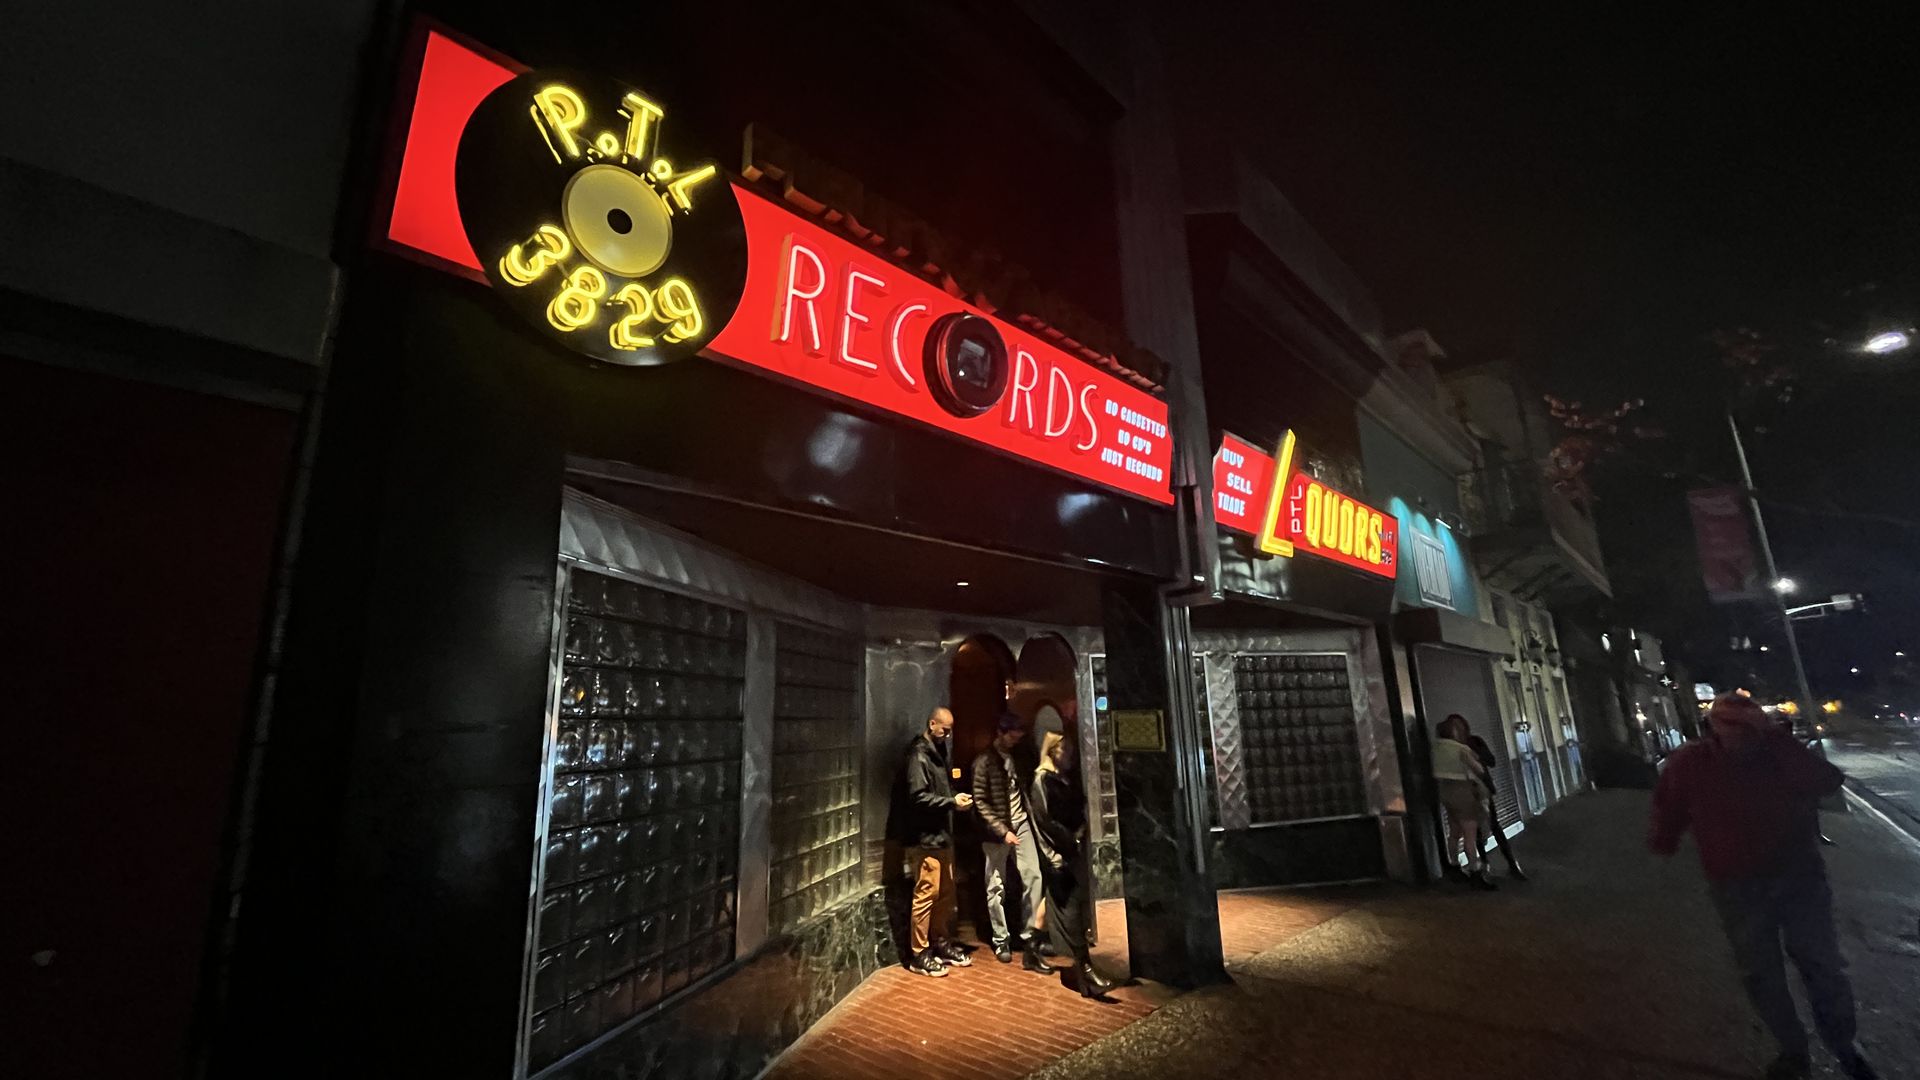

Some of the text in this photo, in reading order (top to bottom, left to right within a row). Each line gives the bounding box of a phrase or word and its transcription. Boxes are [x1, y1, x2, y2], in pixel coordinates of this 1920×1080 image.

[500, 223, 702, 349] 3829
[774, 235, 1099, 454] RECORDS
[1105, 399, 1166, 438] NO CASSETTES
[1118, 429, 1151, 455] NO CD'S
[1101, 447, 1163, 482] JUST RECORDS
[1223, 448, 1244, 468] BUY
[1227, 472, 1252, 494] SELL
[1218, 492, 1245, 517] TRADE
